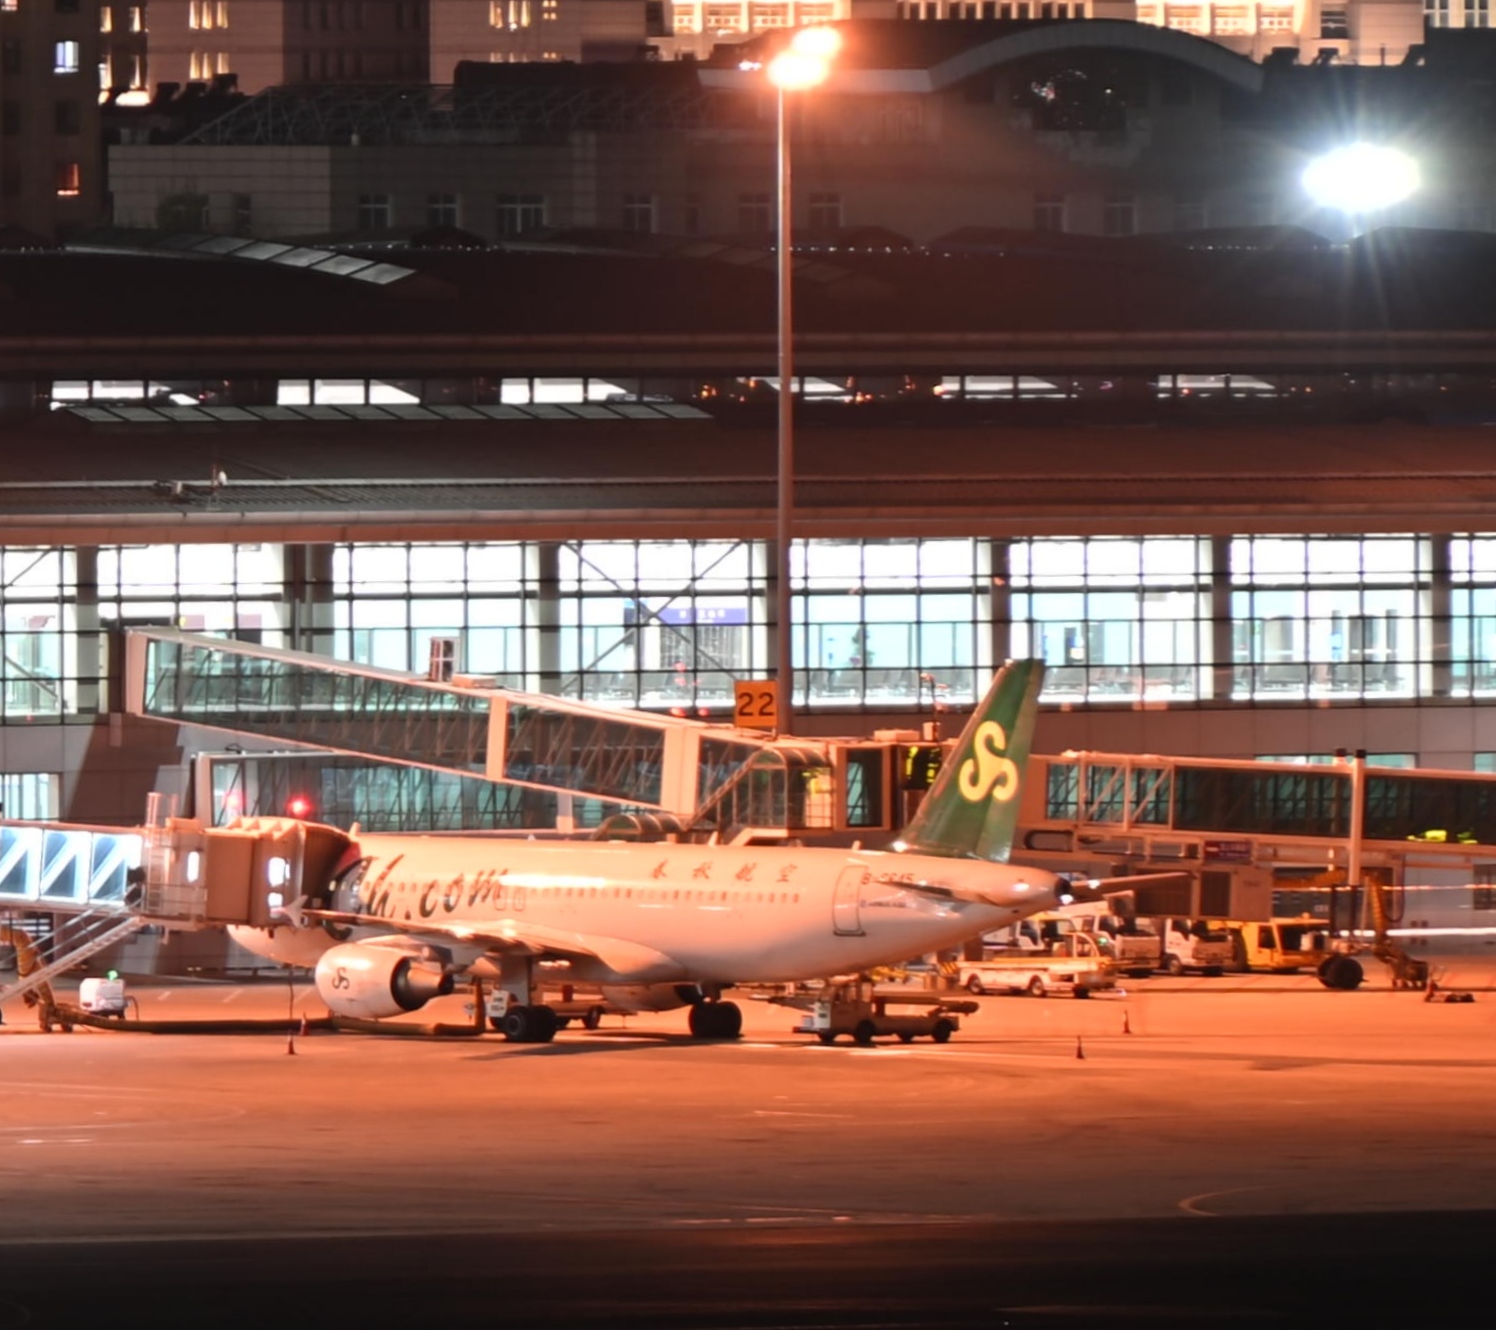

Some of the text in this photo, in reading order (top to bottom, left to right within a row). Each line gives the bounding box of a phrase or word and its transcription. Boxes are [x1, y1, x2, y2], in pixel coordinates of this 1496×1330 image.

[738, 691, 774, 716] 22
[651, 858, 799, 883] 春秋航空
